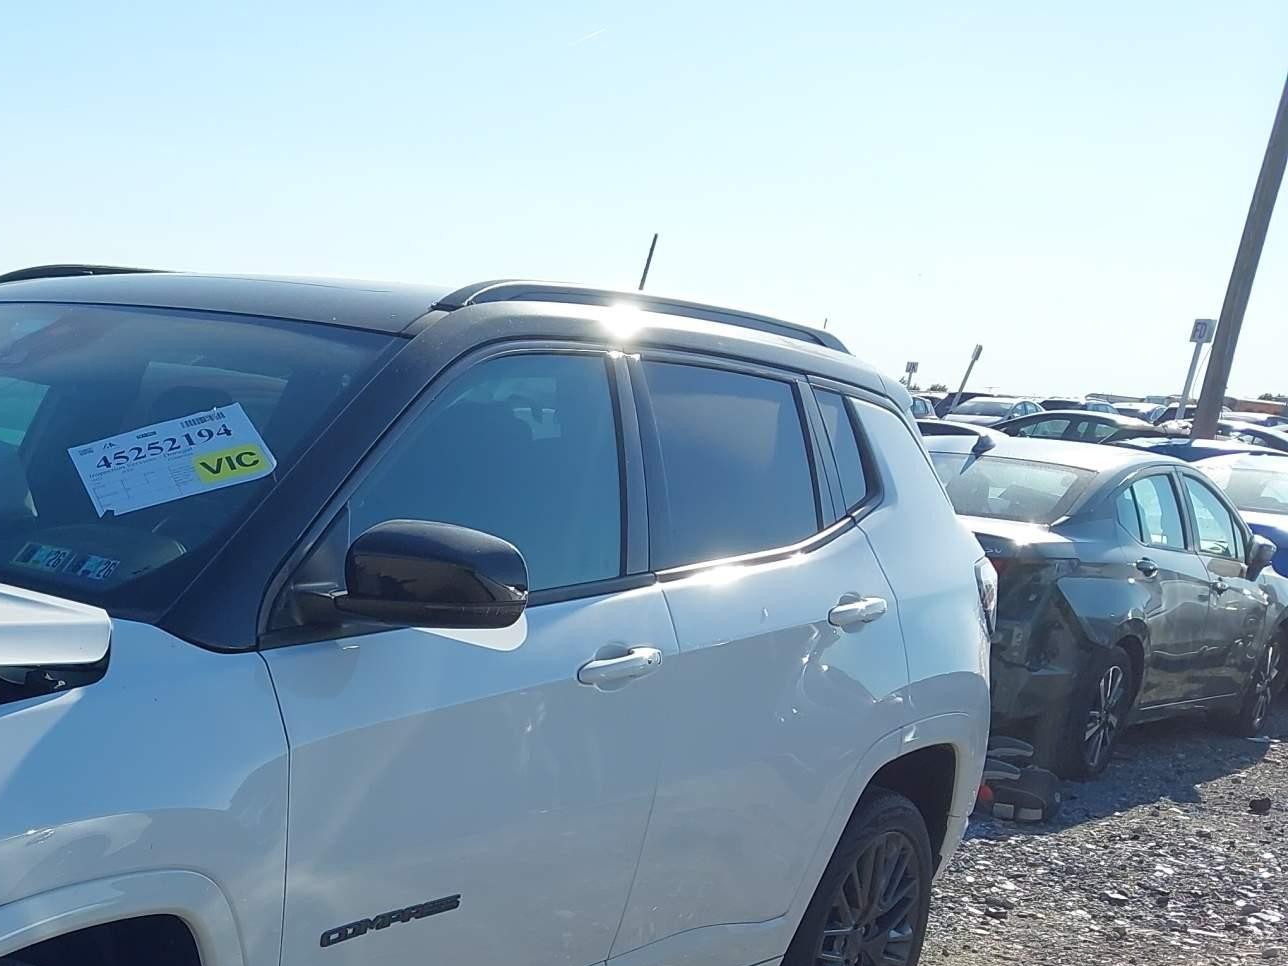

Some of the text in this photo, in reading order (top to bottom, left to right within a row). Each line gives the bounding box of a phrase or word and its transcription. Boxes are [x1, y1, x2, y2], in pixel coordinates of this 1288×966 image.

[96, 423, 233, 469] 45252194
[200, 451, 260, 475] VIC
[46, 550, 67, 568] 26
[96, 560, 117, 578] 26
[320, 893, 461, 948] COMPASS
